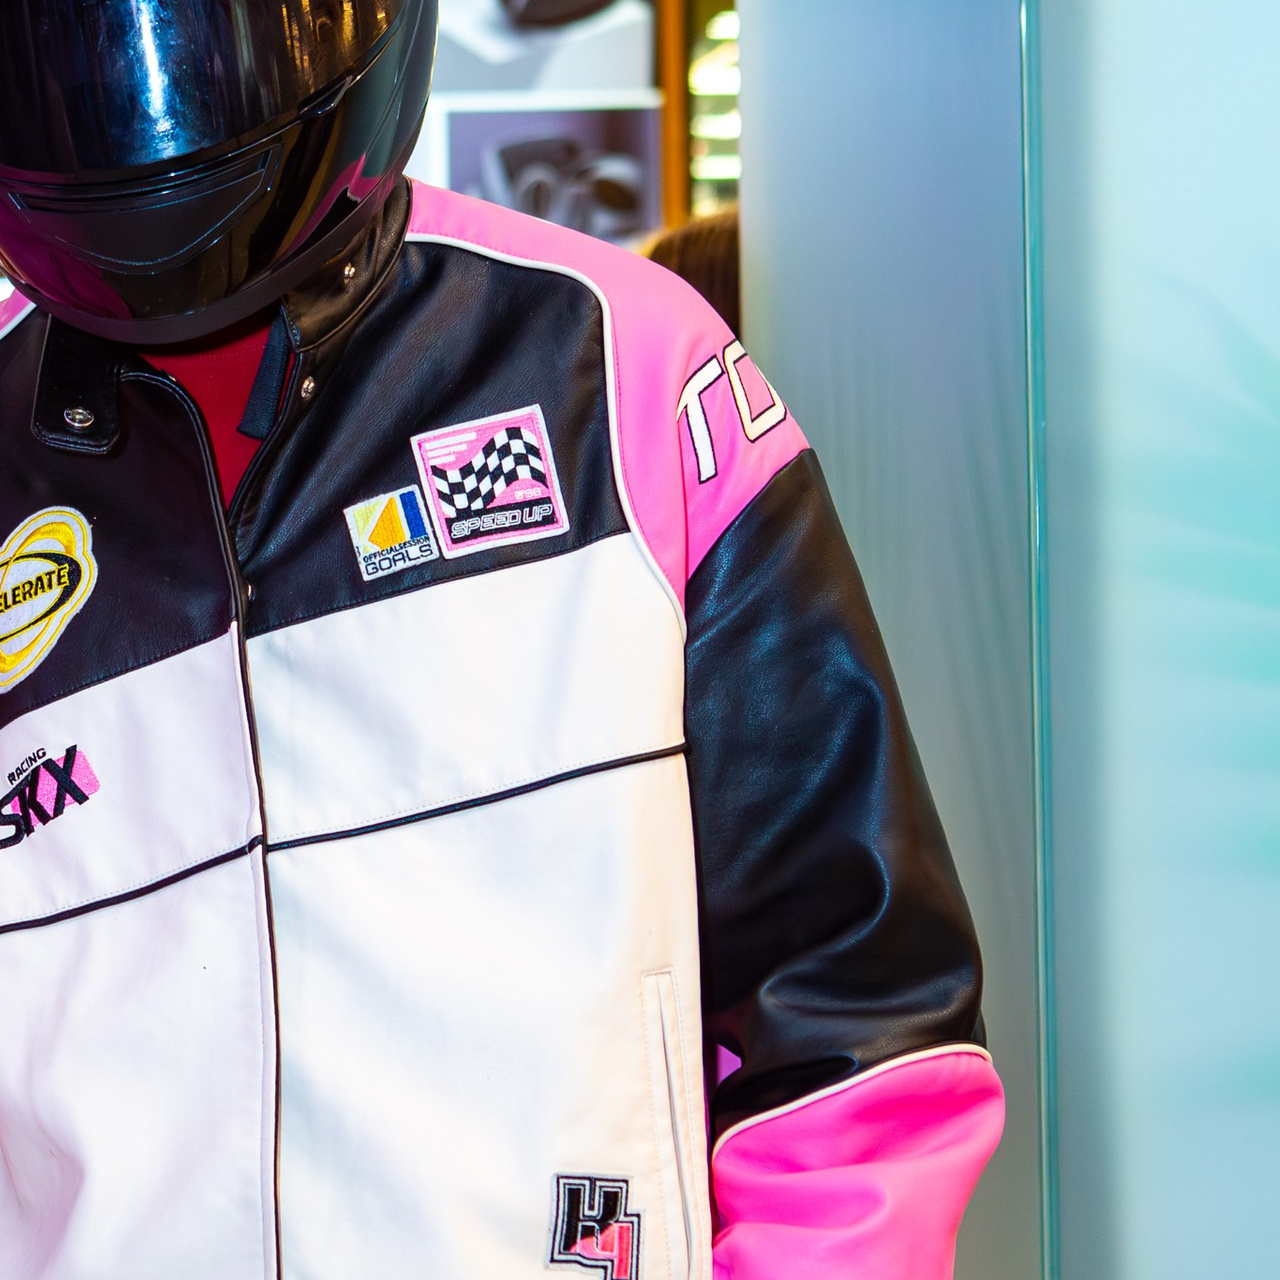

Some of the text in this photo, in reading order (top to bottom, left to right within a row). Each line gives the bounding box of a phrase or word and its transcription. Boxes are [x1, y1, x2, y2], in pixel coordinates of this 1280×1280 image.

[450, 503, 553, 539] SPEED UP
[365, 543, 434, 576] GOALS
[6, 747, 48, 786] RACING
